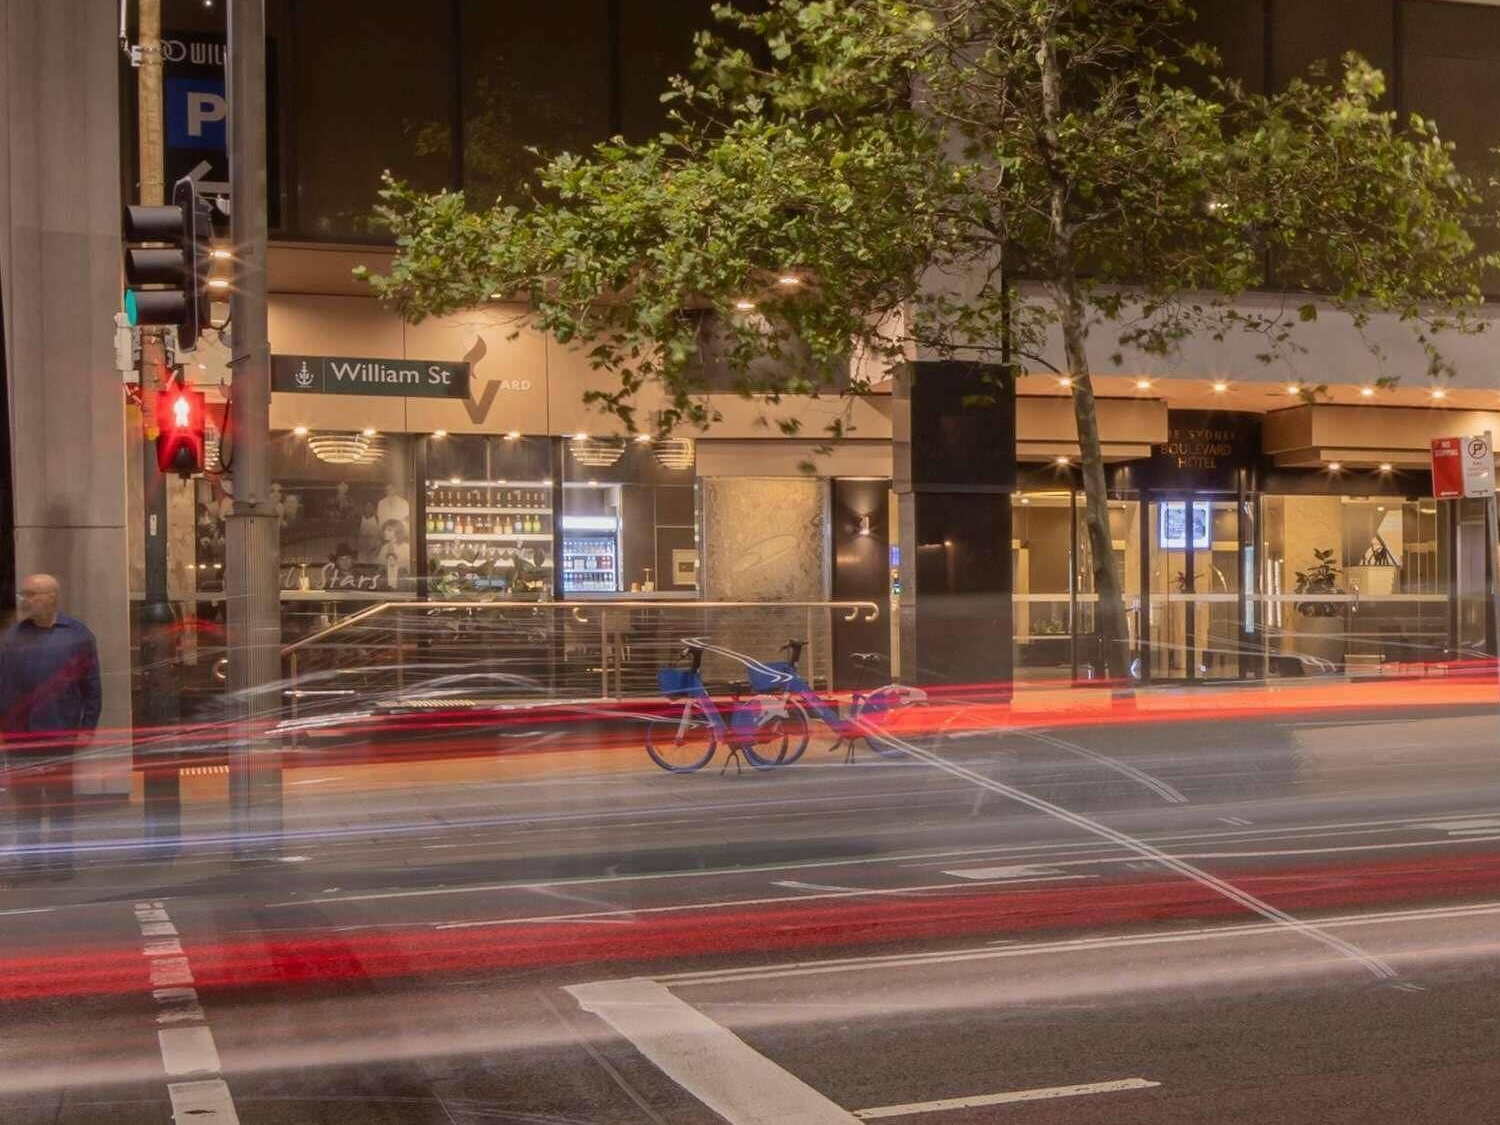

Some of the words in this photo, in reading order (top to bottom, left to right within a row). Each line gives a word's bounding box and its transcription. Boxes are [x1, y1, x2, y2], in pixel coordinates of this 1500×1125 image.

[187, 91, 227, 137] P
[331, 361, 420, 385] William
[427, 365, 452, 385] St
[1160, 442, 1233, 457] BOULEVARD
[1178, 456, 1217, 470] HOTEL
[318, 562, 382, 590] Stars
